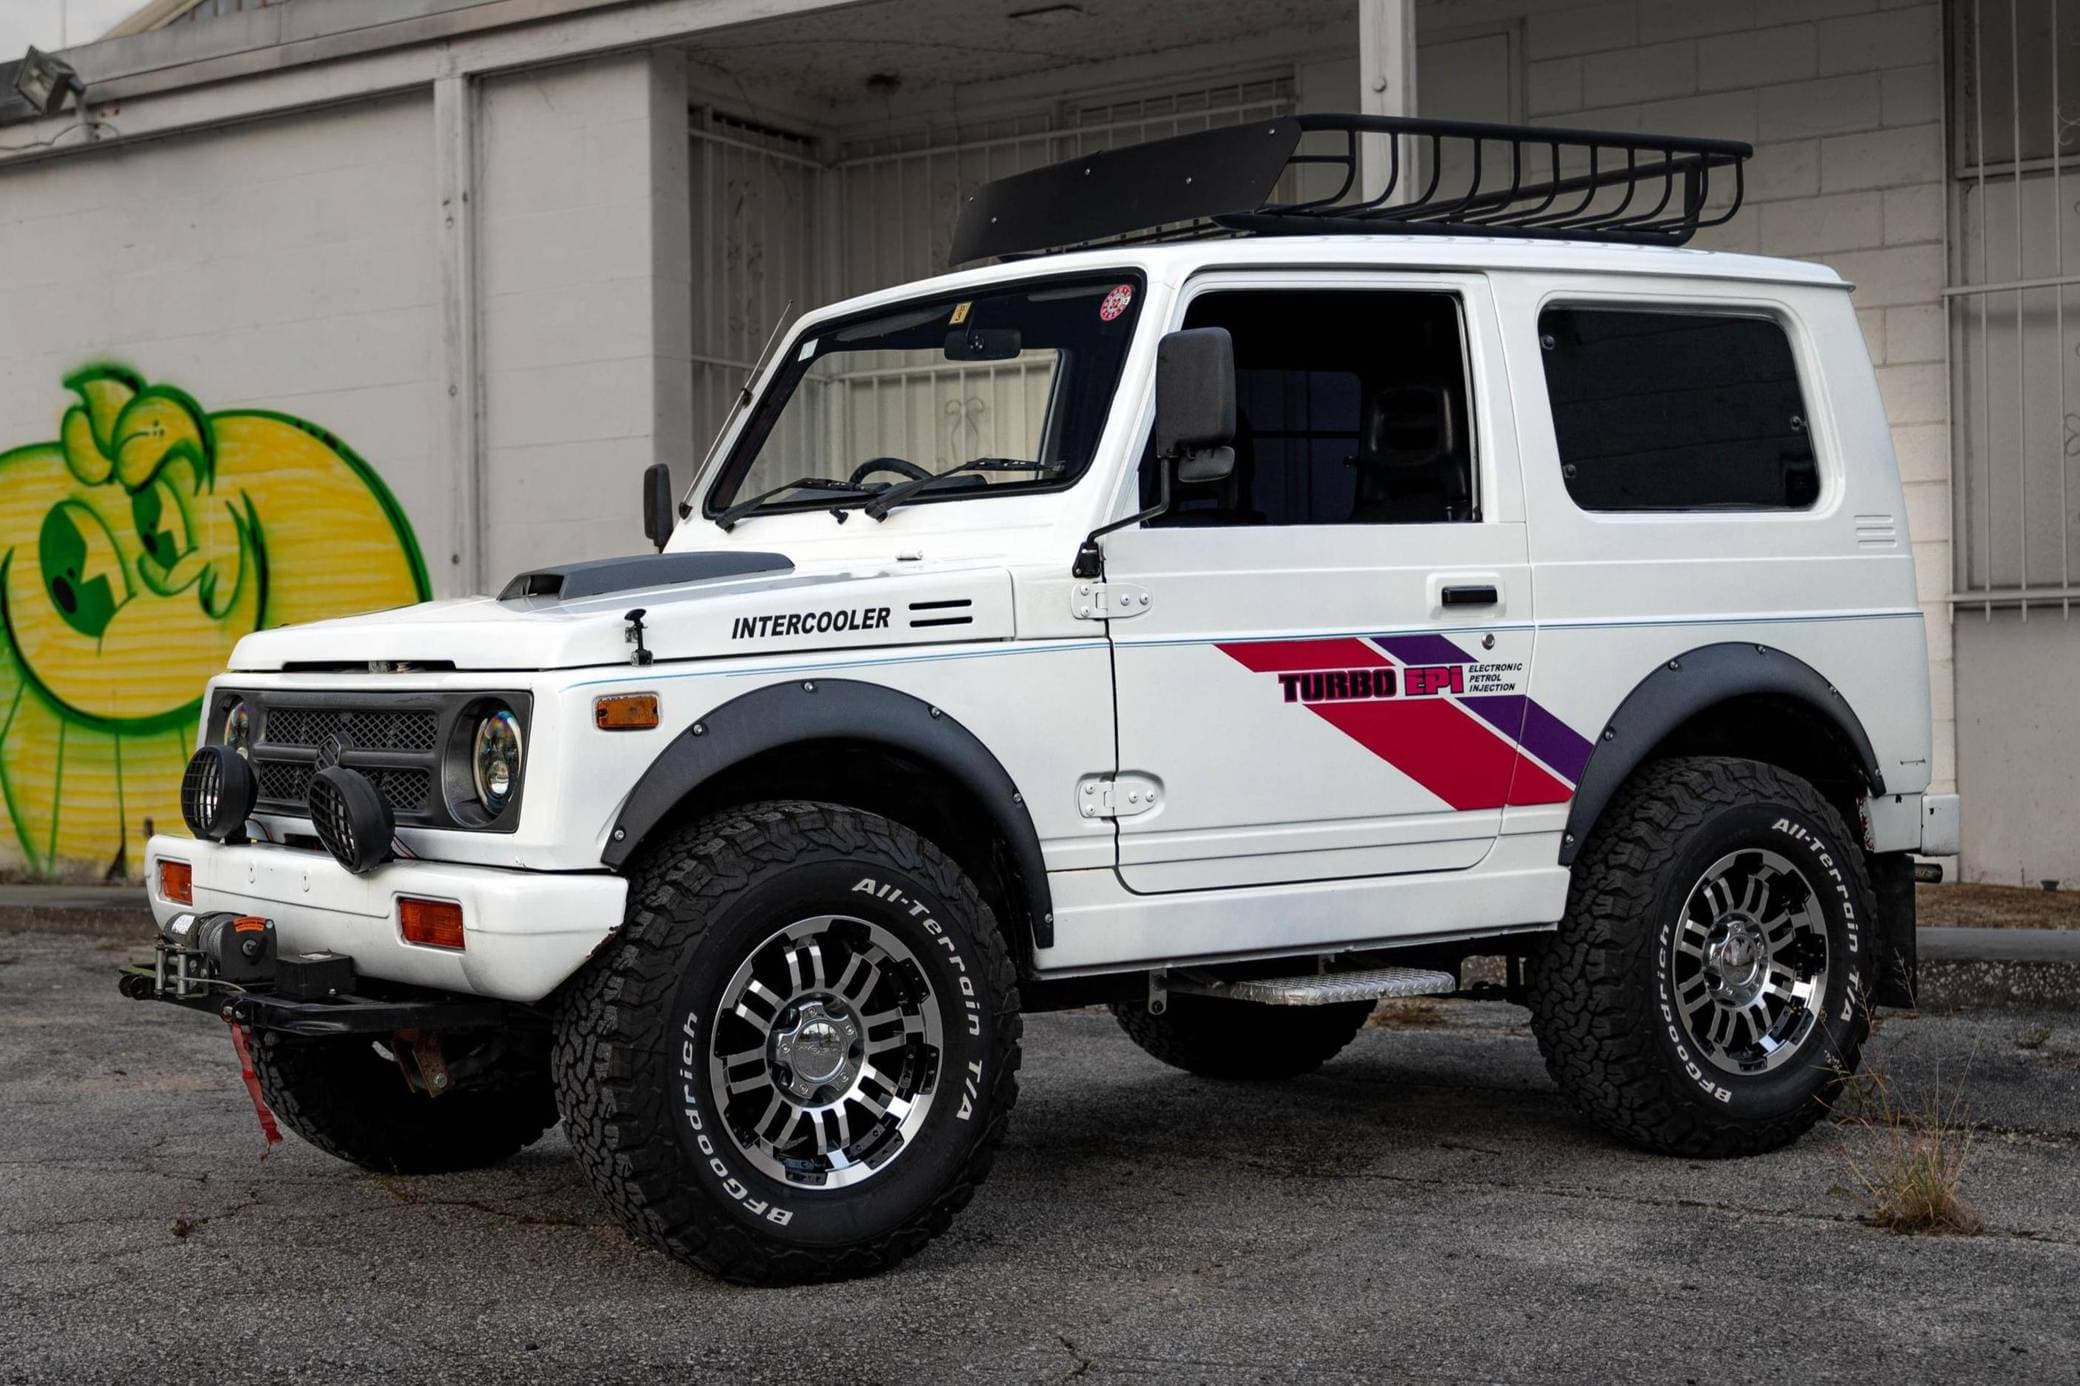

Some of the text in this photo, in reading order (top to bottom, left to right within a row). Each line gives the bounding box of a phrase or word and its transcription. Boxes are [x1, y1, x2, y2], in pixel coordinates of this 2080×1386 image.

[731, 607, 891, 640] INTERCOOLER
[1278, 668, 1397, 703] TURBO
[1468, 663, 1522, 673] ELECTRONIC
[1469, 674, 1502, 683] PETROL
[1469, 683, 1516, 692] INJECTION
[1772, 818, 1860, 1022] All-Terrain T/A
[852, 878, 982, 1121] All-Terrain T/A
[1658, 924, 1732, 1103] BFGoodrich
[680, 1012, 793, 1226] BFGoodrich
